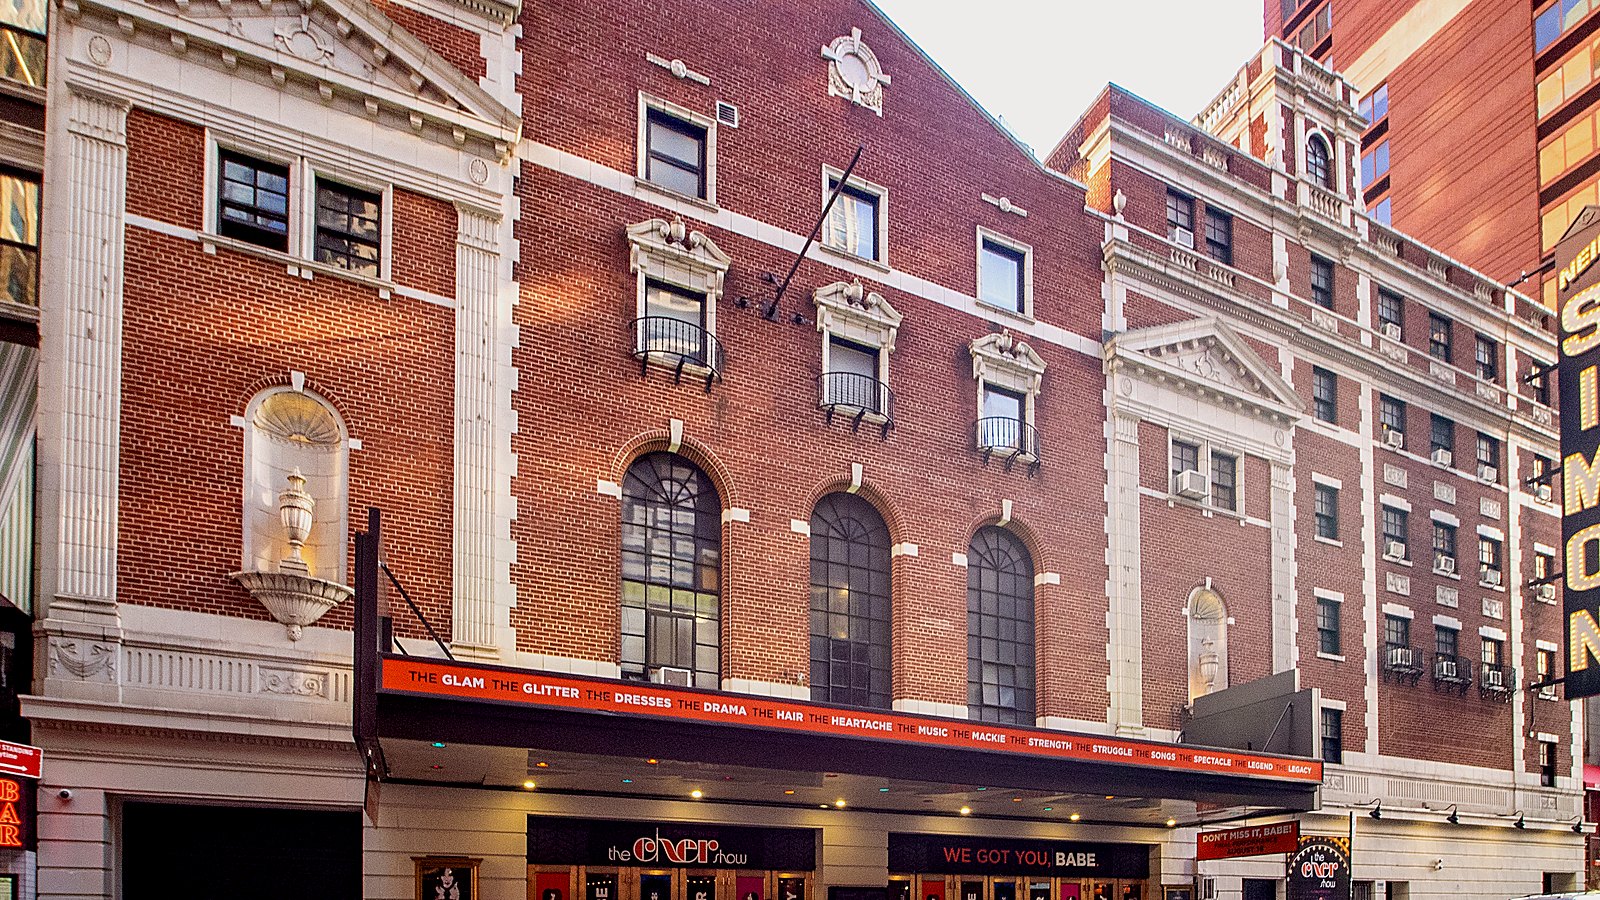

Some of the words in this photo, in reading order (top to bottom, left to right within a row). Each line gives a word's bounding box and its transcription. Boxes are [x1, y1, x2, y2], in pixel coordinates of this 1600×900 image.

[1562, 281, 1600, 673] SIMON
[409, 671, 437, 684] THE
[492, 679, 518, 692] THE
[586, 690, 610, 702] THE
[677, 700, 700, 711] THE
[752, 708, 773, 718] THE
[808, 714, 828, 724] THE
[897, 723, 916, 734] THE
[953, 729, 969, 739] THE
[1010, 736, 1026, 745] THE
[1076, 743, 1091, 752] THE
[1135, 749, 1149, 758] THE
[1179, 754, 1192, 762] THE
[1288, 765, 1312, 774] LEGACY
[2, 744, 33, 756] STANDING
[0, 779, 21, 846] BAR
[1202, 832, 1228, 843] DON'T
[1230, 830, 1250, 840] MISS
[1251, 829, 1262, 838] IT,
[1263, 825, 1292, 836] BABE!
[608, 845, 631, 861] the
[713, 849, 747, 864] show
[943, 847, 971, 863] WE
[977, 849, 1010, 864] GOT
[1015, 850, 1051, 868] YOU,
[1055, 852, 1099, 867] BABE.
[1314, 852, 1325, 861] the
[1320, 879, 1336, 888] show
